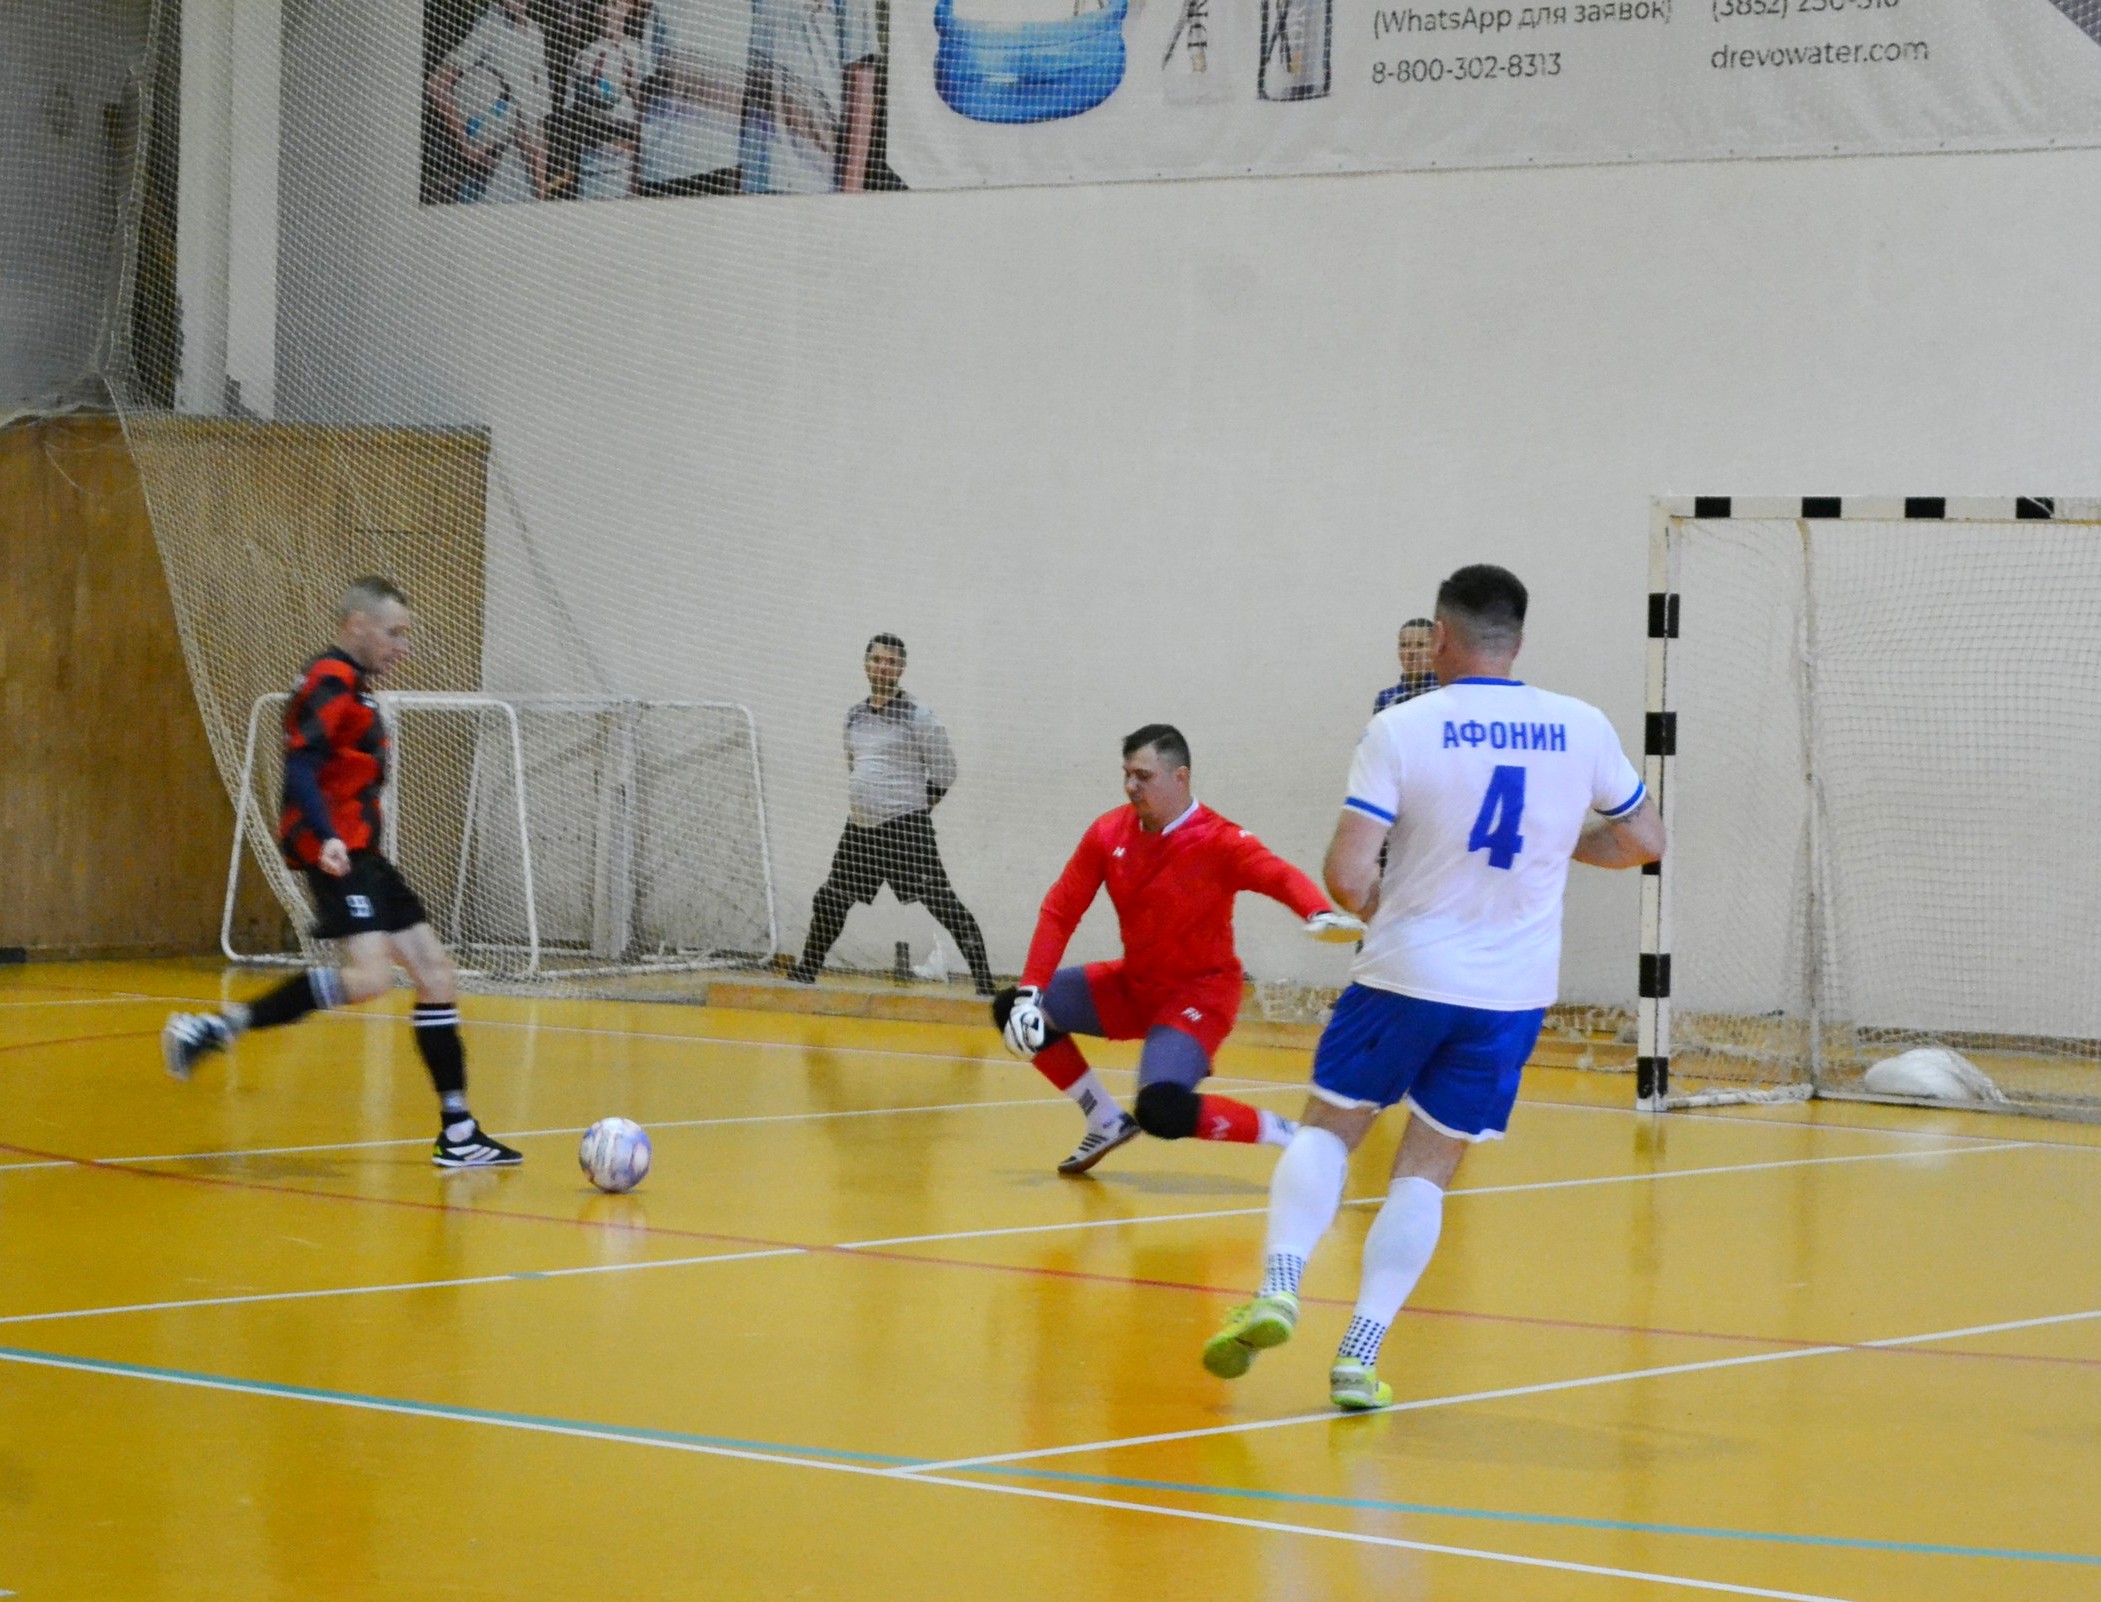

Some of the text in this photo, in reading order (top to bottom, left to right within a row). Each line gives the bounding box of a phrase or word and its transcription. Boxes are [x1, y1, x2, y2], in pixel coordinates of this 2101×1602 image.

[1373, 0, 1673, 39] (WhatsApp для заявок)
[1372, 53, 1562, 84] 8-800-302-8313
[1711, 40, 1929, 69] drevowater.com
[1443, 720, 1566, 751] АФОНИН
[1468, 765, 1526, 870] 4
